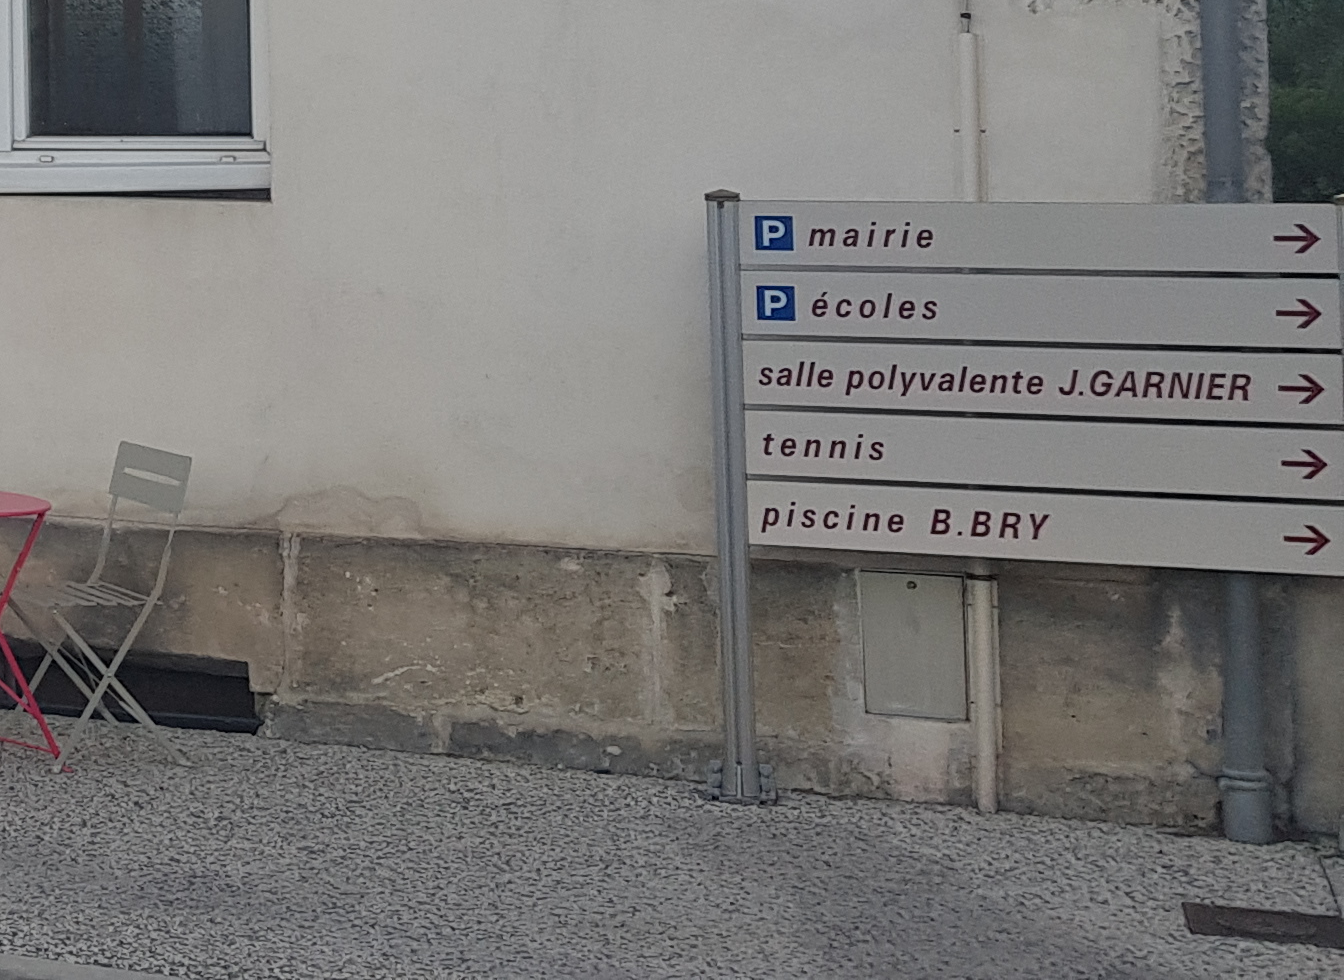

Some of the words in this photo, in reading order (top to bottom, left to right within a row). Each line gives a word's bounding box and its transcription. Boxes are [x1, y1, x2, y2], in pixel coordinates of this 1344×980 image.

[808, 222, 935, 249] mairie
[811, 291, 939, 321] écoles
[759, 362, 835, 388] salle
[845, 364, 1045, 396] polyvalente
[1059, 370, 1252, 402] J.GARNIER
[762, 433, 886, 462] tennis
[761, 502, 906, 534] piscine
[930, 509, 1052, 541] B.BRY
